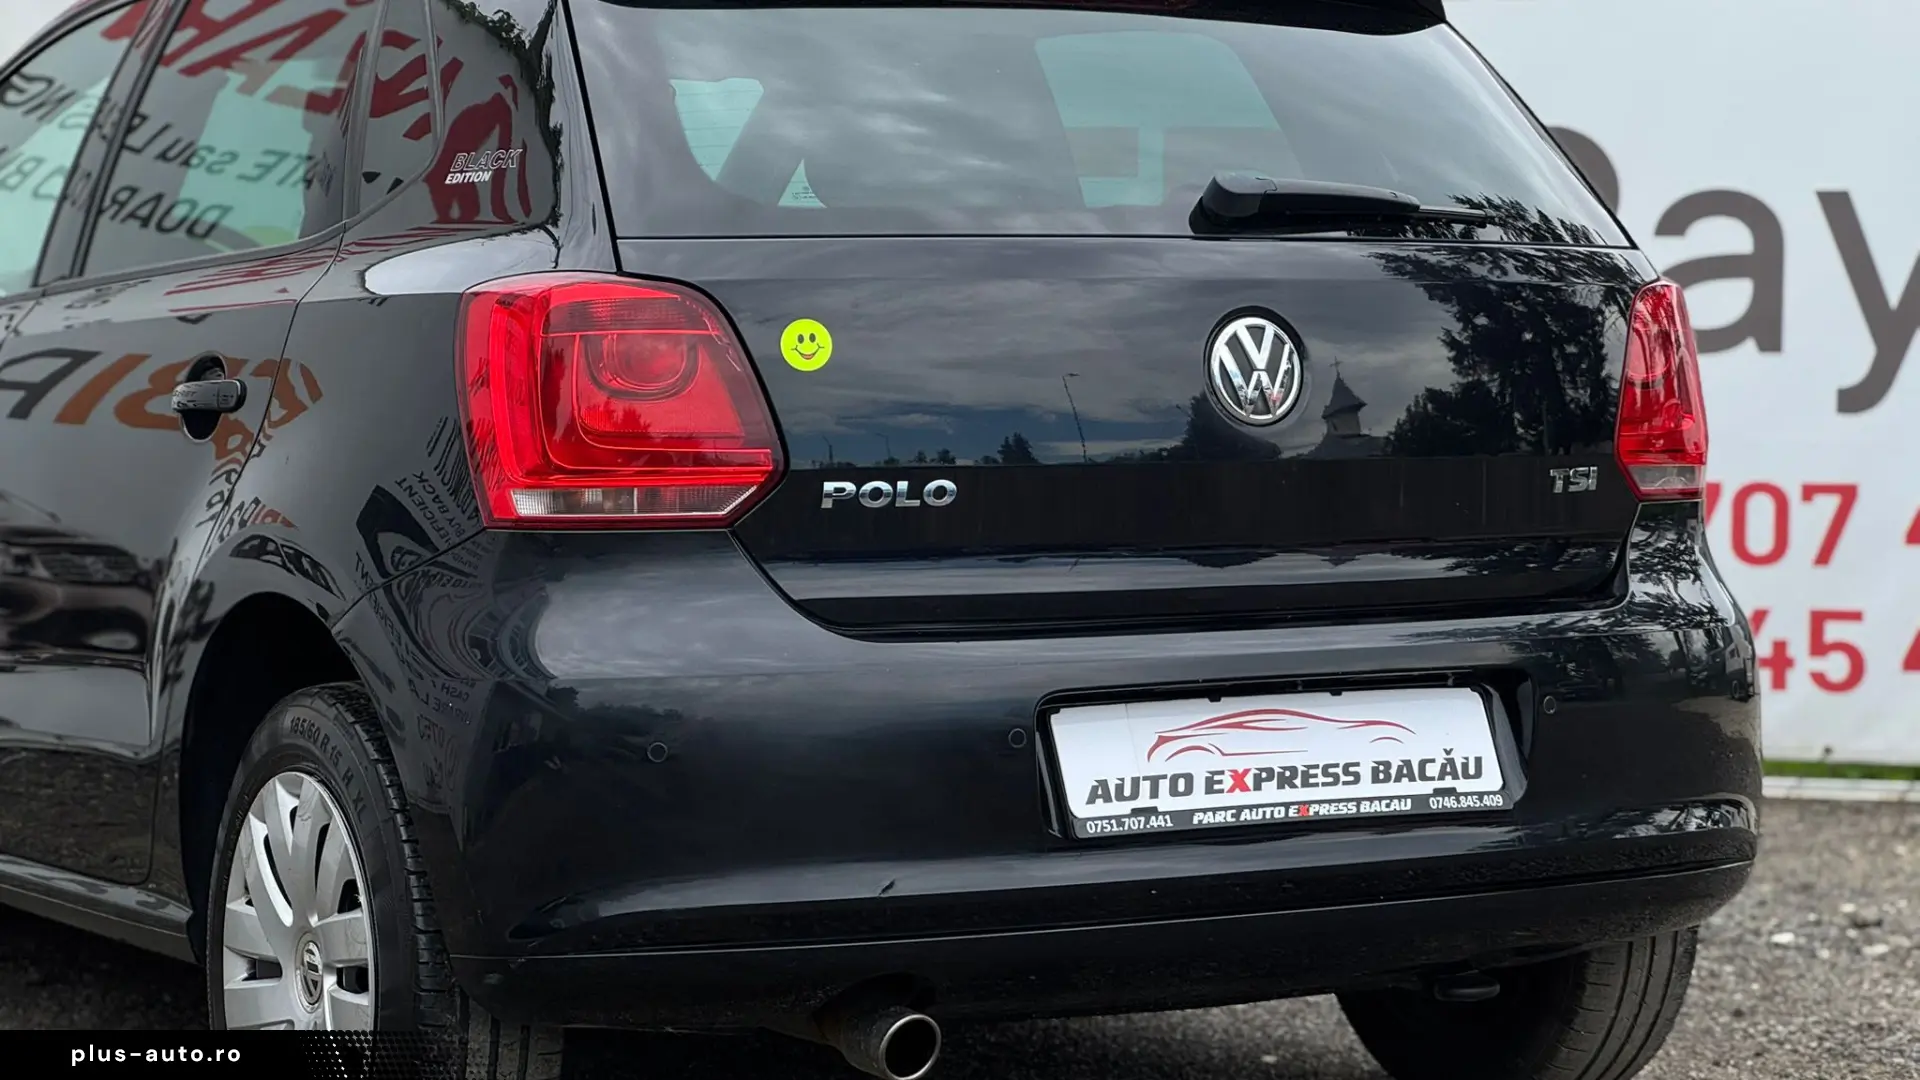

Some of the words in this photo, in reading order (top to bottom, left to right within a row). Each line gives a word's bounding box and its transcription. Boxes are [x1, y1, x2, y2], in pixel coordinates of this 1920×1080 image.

[449, 148, 524, 172] BLACK
[444, 170, 493, 185] EDITION
[1548, 126, 1920, 415] ay
[821, 479, 958, 509] POLO
[1549, 466, 1598, 493] TSI
[289, 716, 322, 744] 185/60
[320, 733, 331, 754] R
[1085, 772, 1195, 806] AUTO
[1205, 761, 1361, 796] EXPRESS
[1370, 748, 1483, 785] BACĂU
[1086, 814, 1175, 834] 0751.707.441
[1192, 808, 1237, 825] PARC
[1240, 805, 1285, 822] AUTO
[1288, 801, 1358, 818] EXPRESS
[1359, 797, 1412, 814] BACAU
[1429, 794, 1504, 810] 0746.845.409
